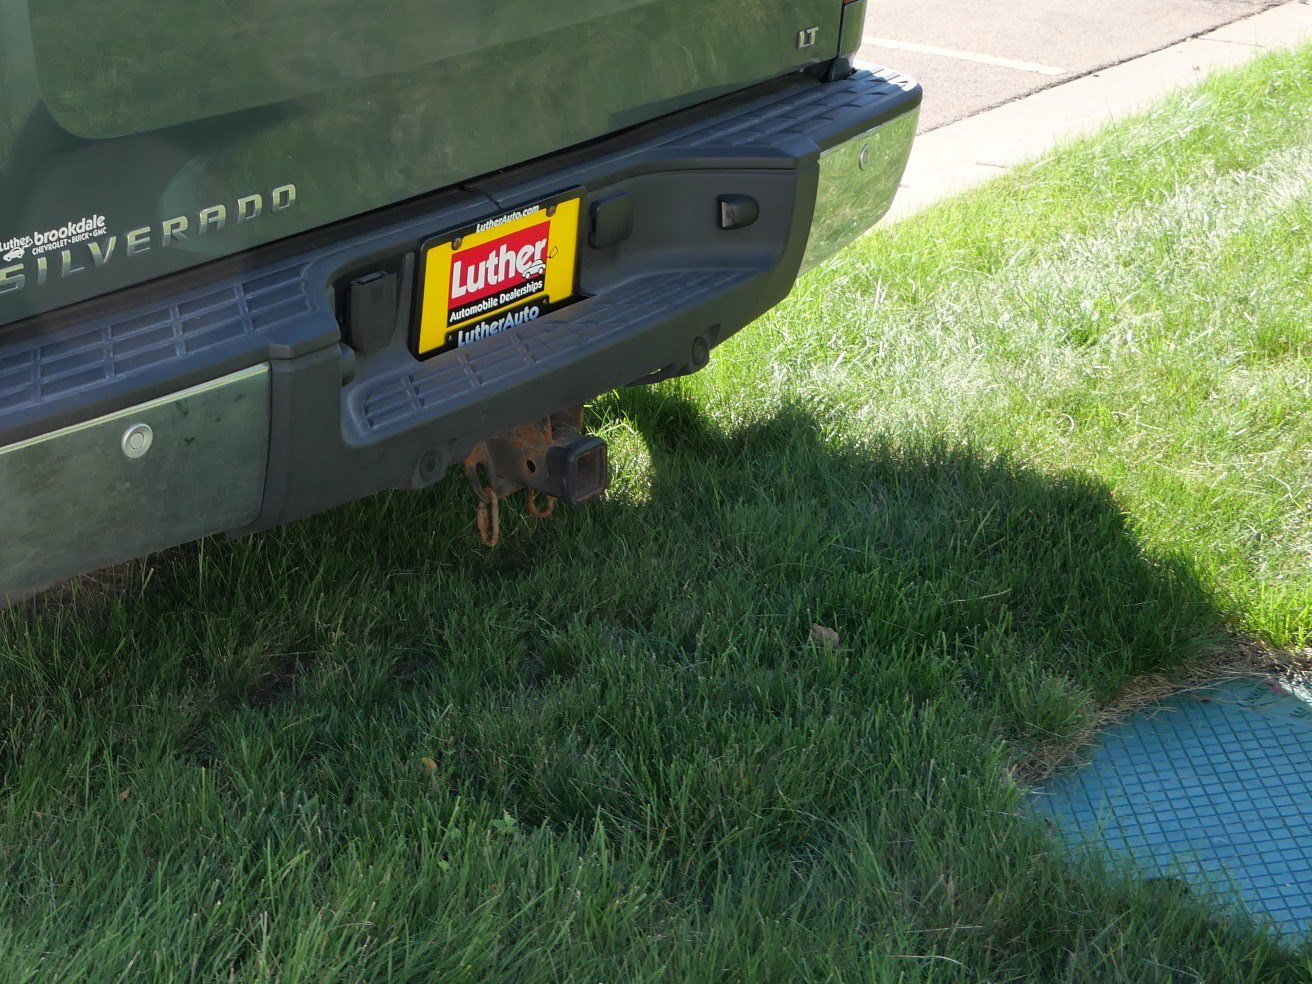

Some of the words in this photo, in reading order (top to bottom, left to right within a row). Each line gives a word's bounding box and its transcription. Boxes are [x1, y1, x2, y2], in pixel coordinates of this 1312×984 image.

[797, 26, 819, 50] LT
[33, 214, 106, 246] brookdale
[475, 204, 540, 234] LutherAuto.com
[31, 238, 68, 256] CHEVROLET
[71, 233, 90, 244] BUICK
[93, 226, 107, 237] GMC
[451, 238, 547, 300] Luther
[449, 297, 498, 323] Automobile
[499, 280, 543, 304] Dealerships
[457, 306, 540, 348] LutherAuto
